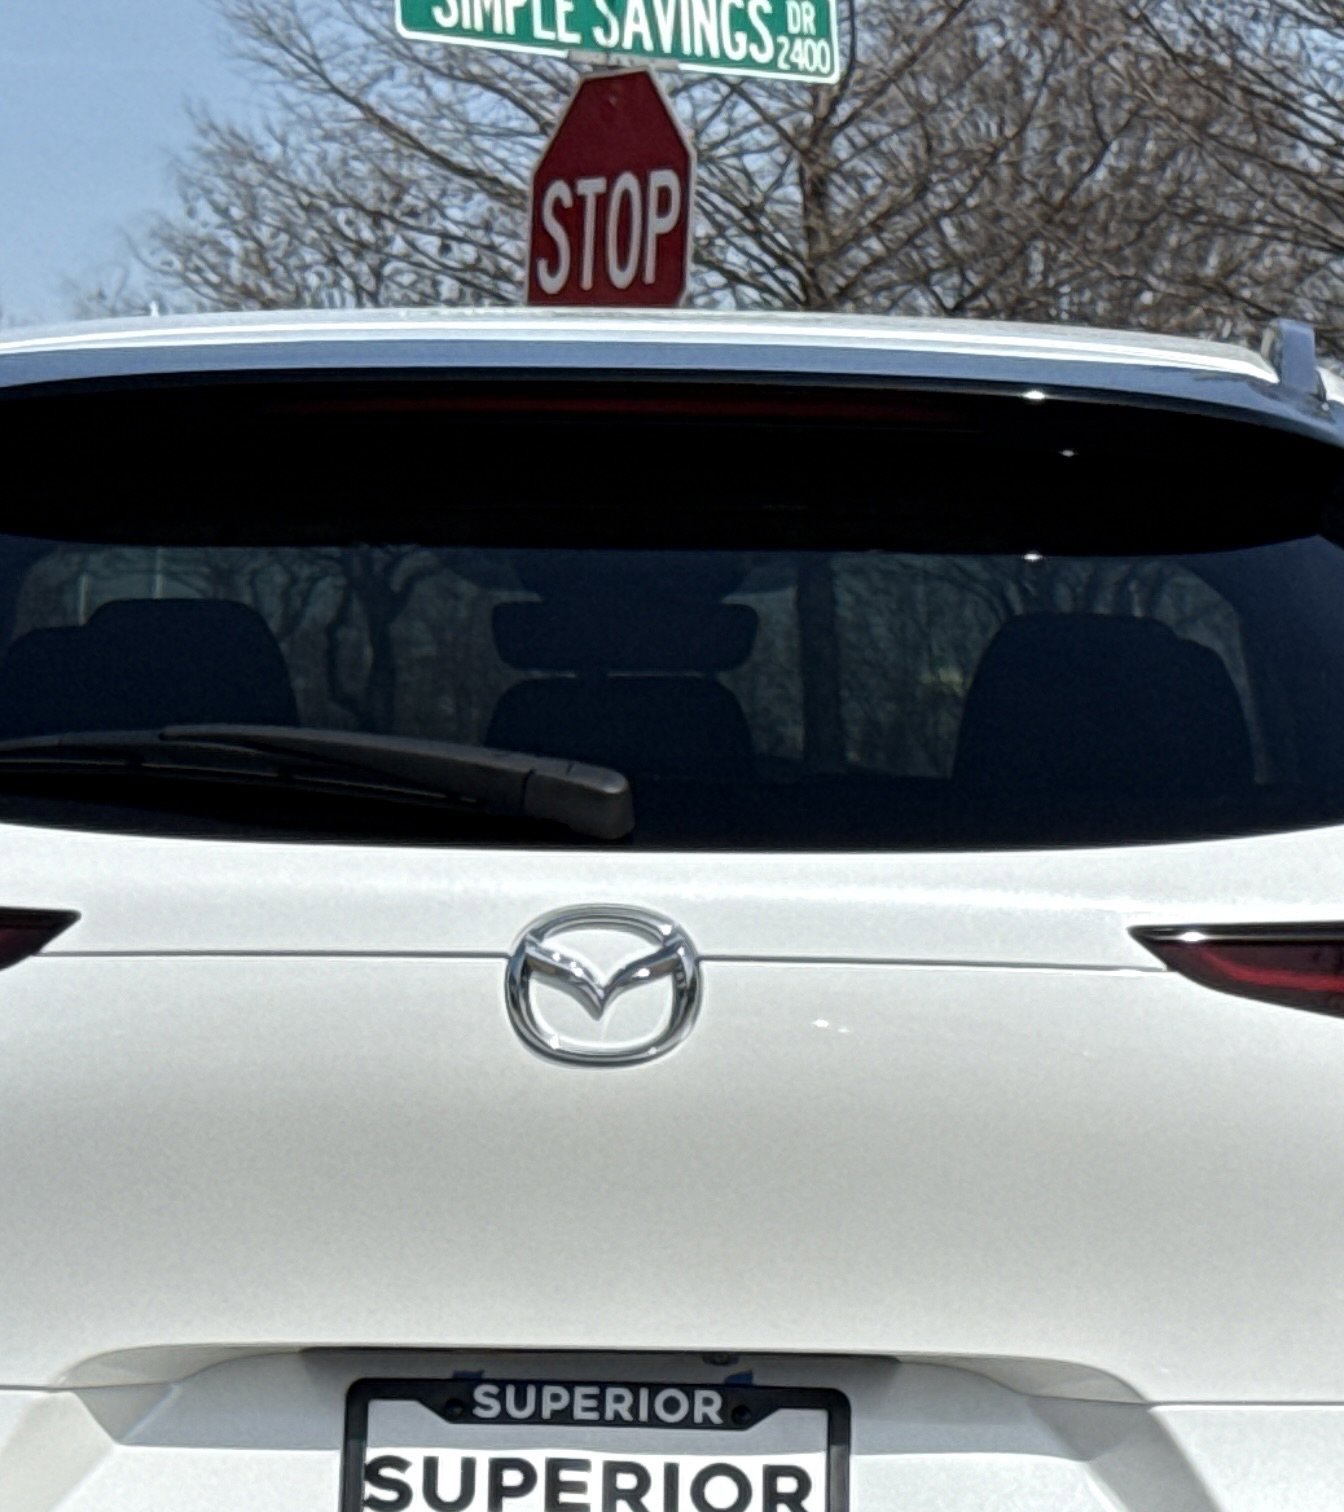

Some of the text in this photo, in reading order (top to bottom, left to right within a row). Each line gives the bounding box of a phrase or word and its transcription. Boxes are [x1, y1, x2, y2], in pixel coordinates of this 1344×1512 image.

[591, 0, 775, 63] SAVINGS
[786, 0, 817, 35] DR
[777, 35, 831, 73] 2400
[537, 169, 681, 295] STOP
[471, 1384, 724, 1425] SUPERIOR
